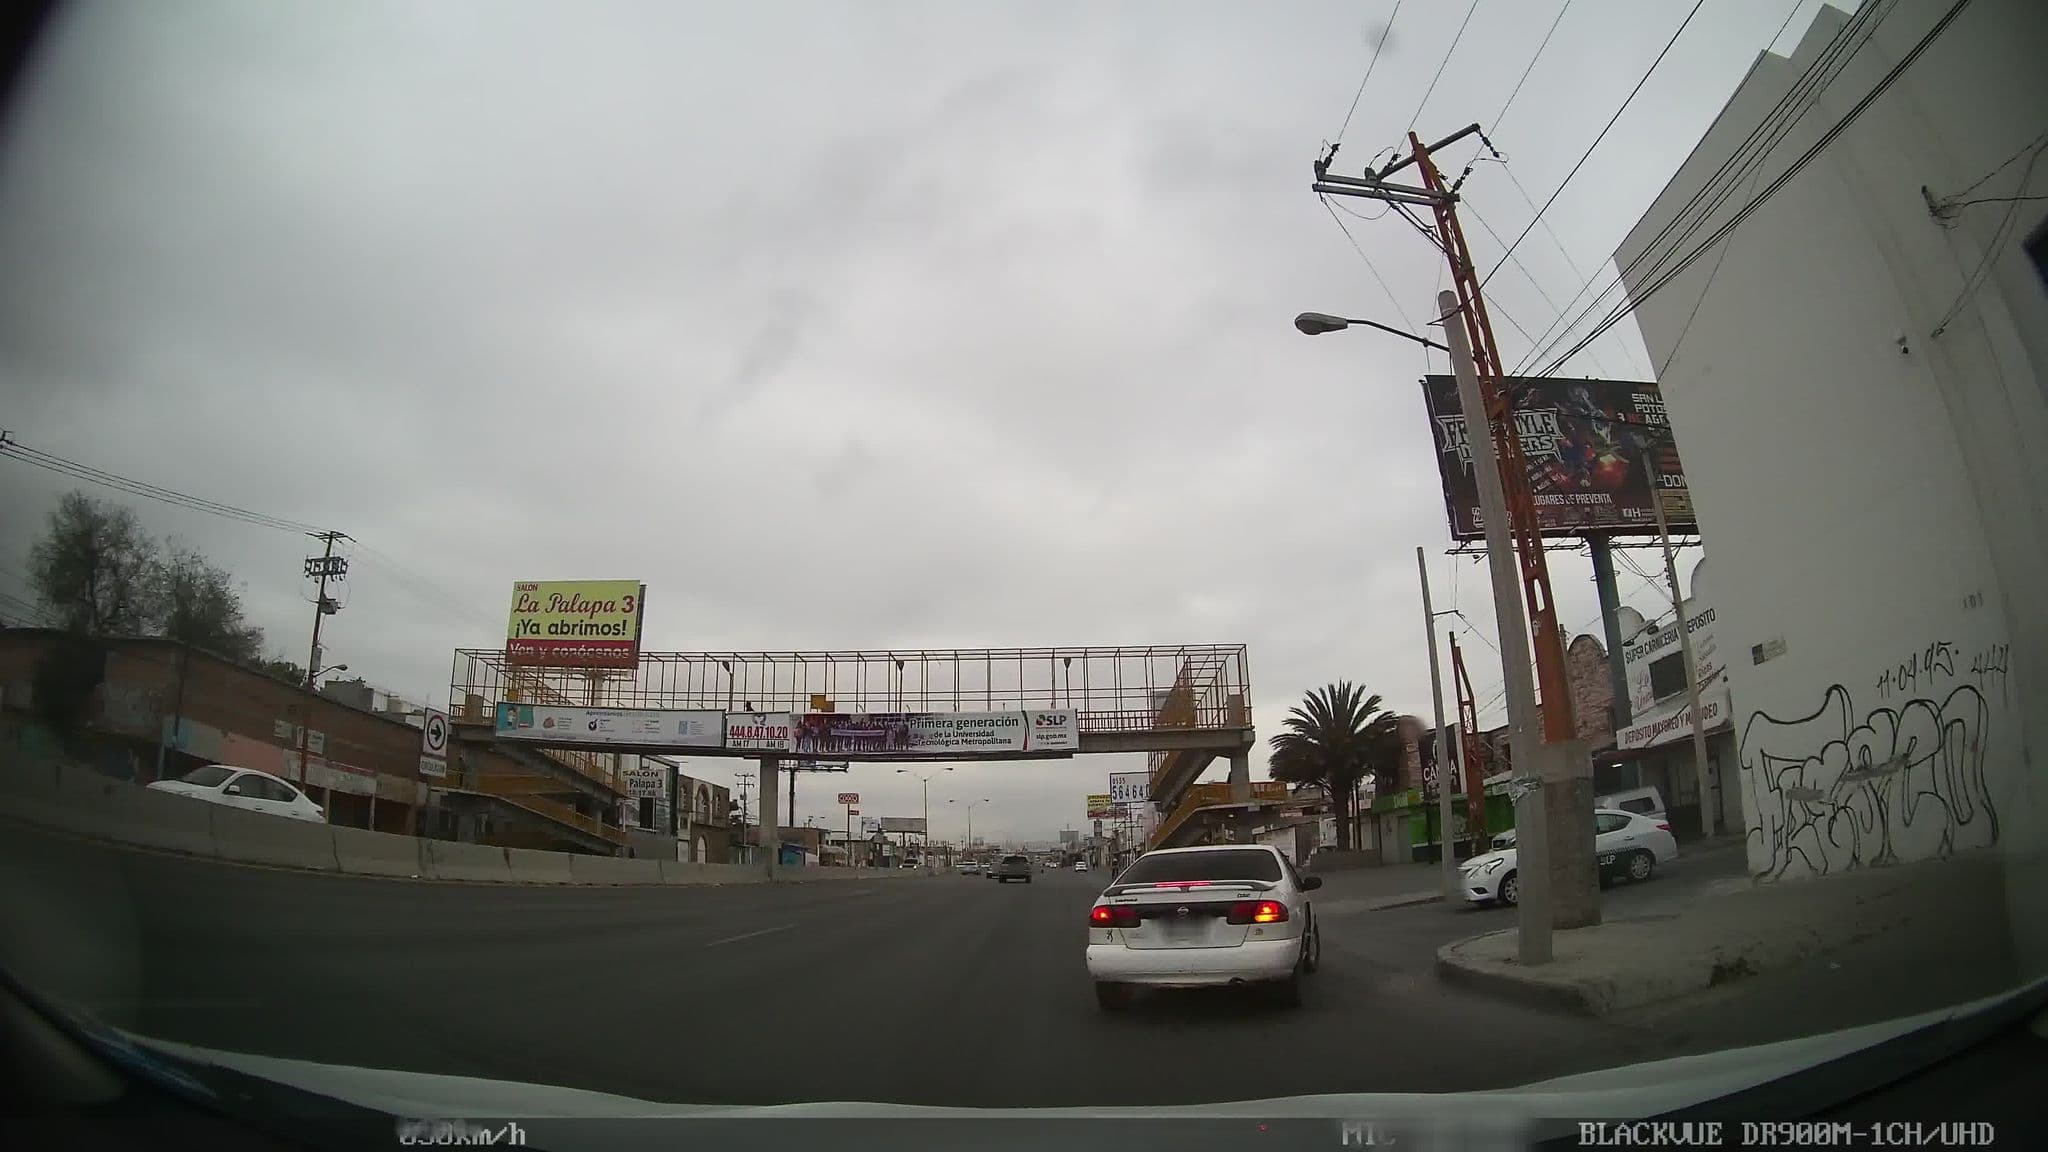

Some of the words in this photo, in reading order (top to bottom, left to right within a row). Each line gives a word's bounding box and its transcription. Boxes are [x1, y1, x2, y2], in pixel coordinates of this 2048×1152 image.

[1576, 493, 1612, 504] PREVENTA
[514, 593, 541, 613] La
[545, 593, 617, 619] Palapa
[621, 595, 635, 613] 3
[515, 619, 541, 638] ¡Ya
[548, 619, 628, 636] abrimos!
[1625, 646, 1644, 664] SUPER
[1685, 608, 1716, 633] EPOSITO
[510, 643, 534, 655] Ven
[539, 646, 548, 659] y
[552, 644, 630, 659] conócenos
[910, 717, 953, 729] Primera
[956, 716, 1019, 730] generación
[1046, 714, 1067, 726] SLP
[933, 730, 943, 738] de
[944, 730, 951, 738] la
[952, 730, 1005, 738] Universidad
[732, 739, 742, 748] AM
[766, 740, 776, 748] AM
[918, 738, 960, 747] Tecnológica
[961, 737, 1012, 747] Metropolitana
[630, 779, 656, 790] Palapa
[657, 779, 663, 788] 3
